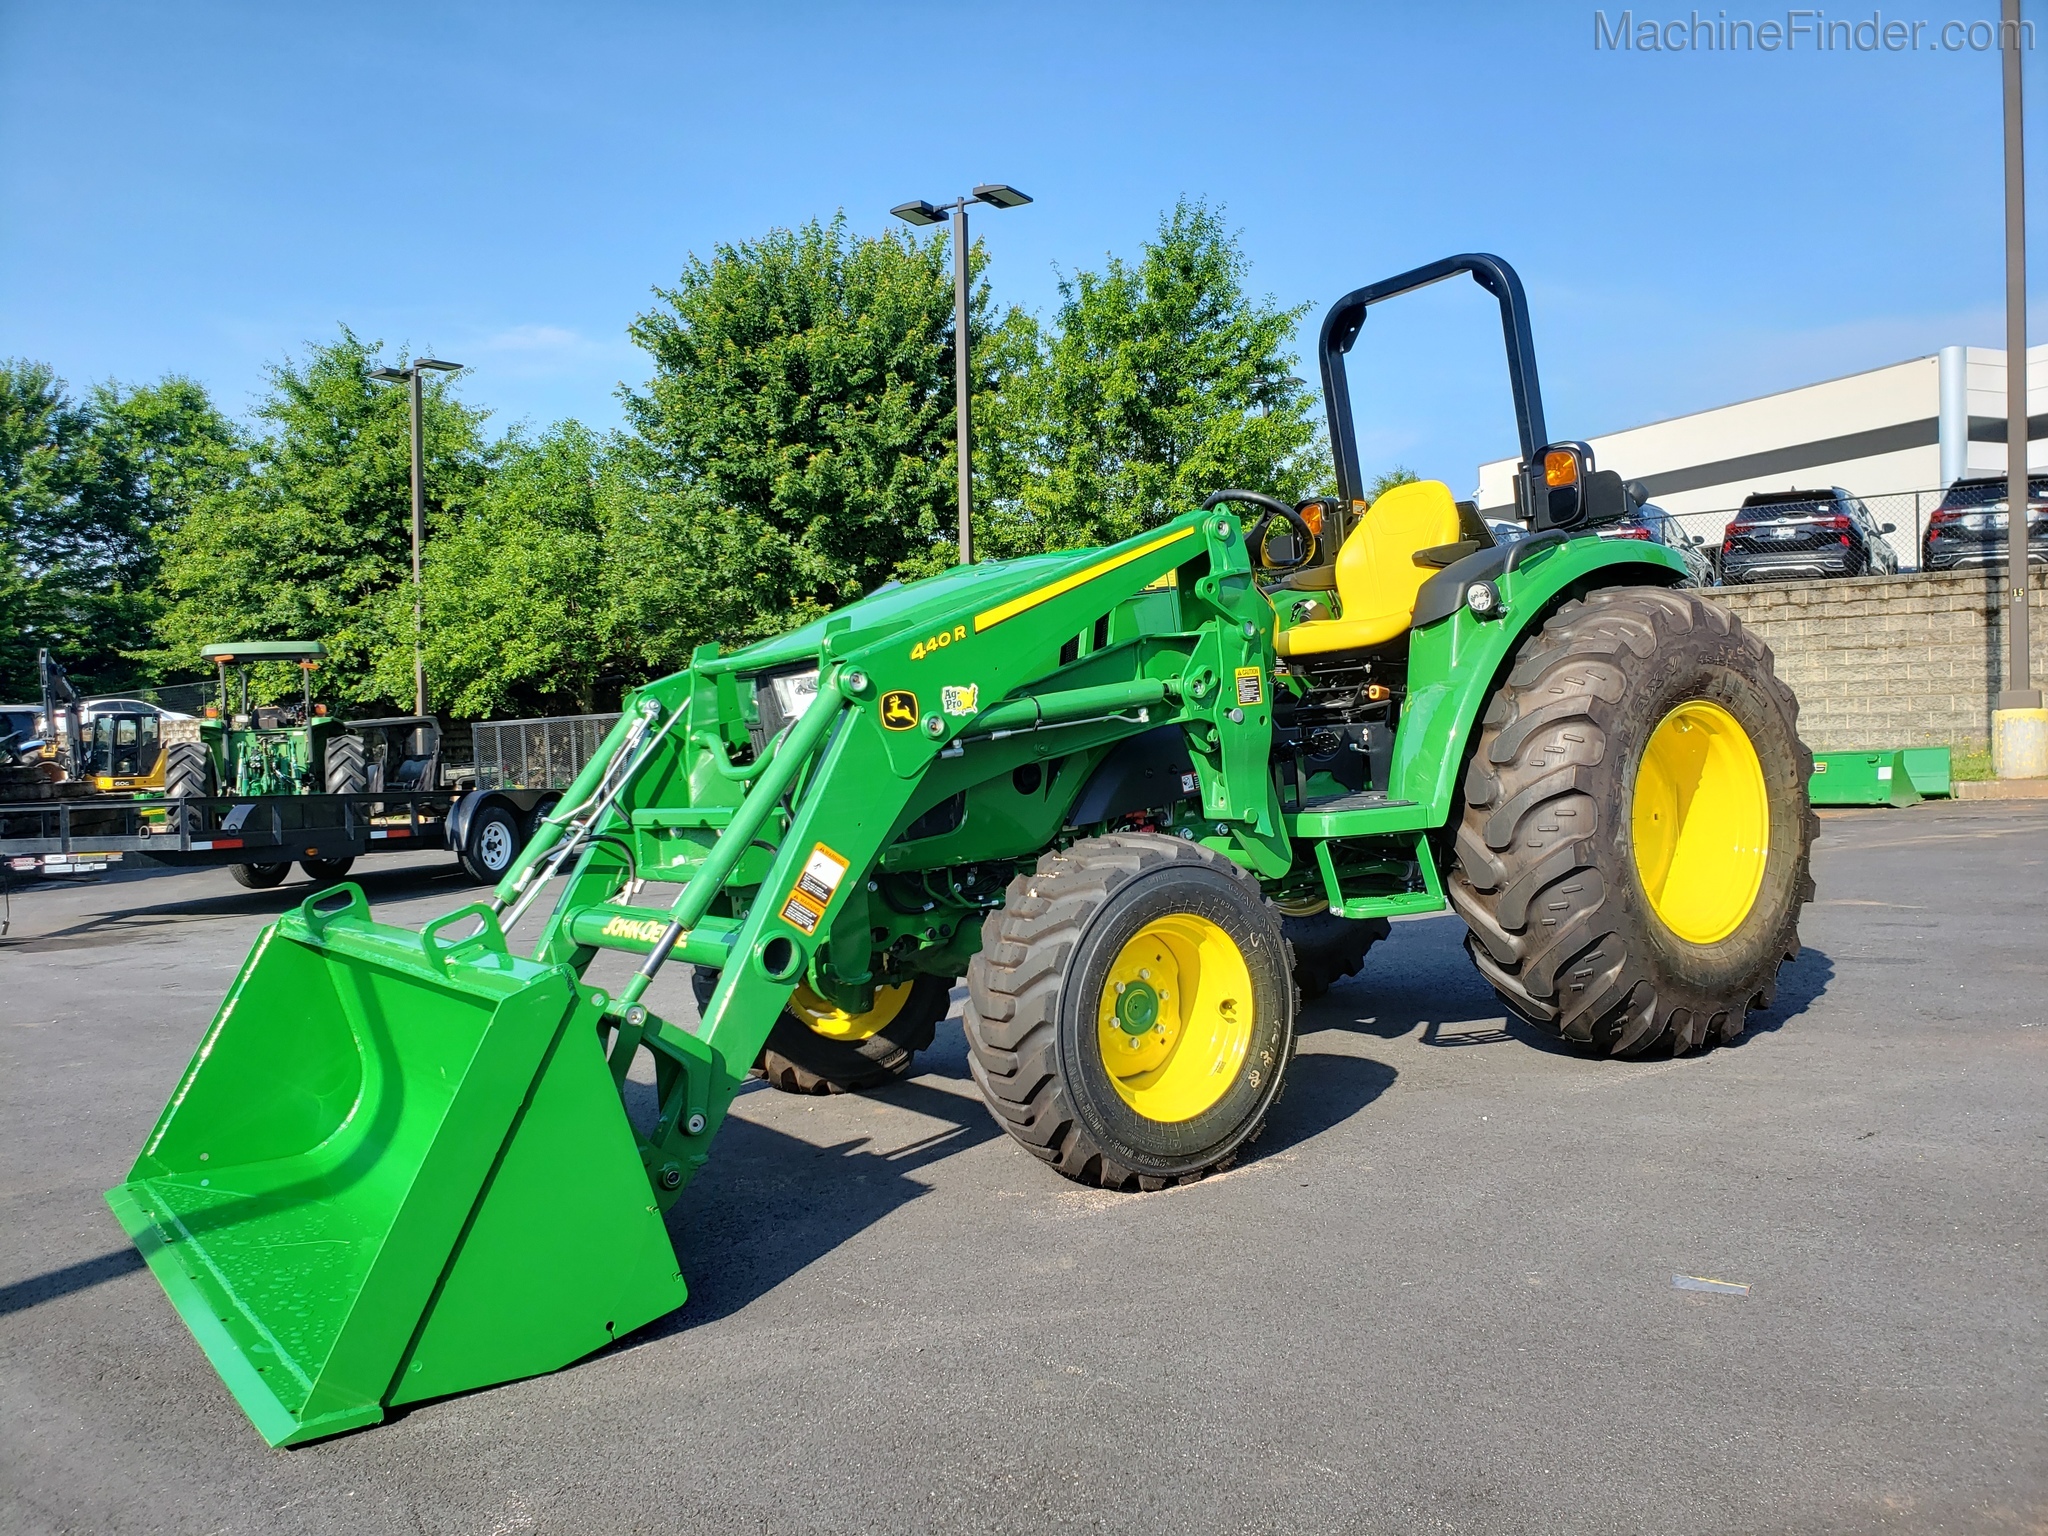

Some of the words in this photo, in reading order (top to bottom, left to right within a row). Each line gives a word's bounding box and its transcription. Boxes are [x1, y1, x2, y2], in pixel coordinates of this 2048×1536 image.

[2013, 588, 2024, 597] 15
[910, 631, 952, 660] 440
[954, 625, 967, 642] R
[945, 700, 962, 710] Pro
[603, 916, 641, 938] JOHN
